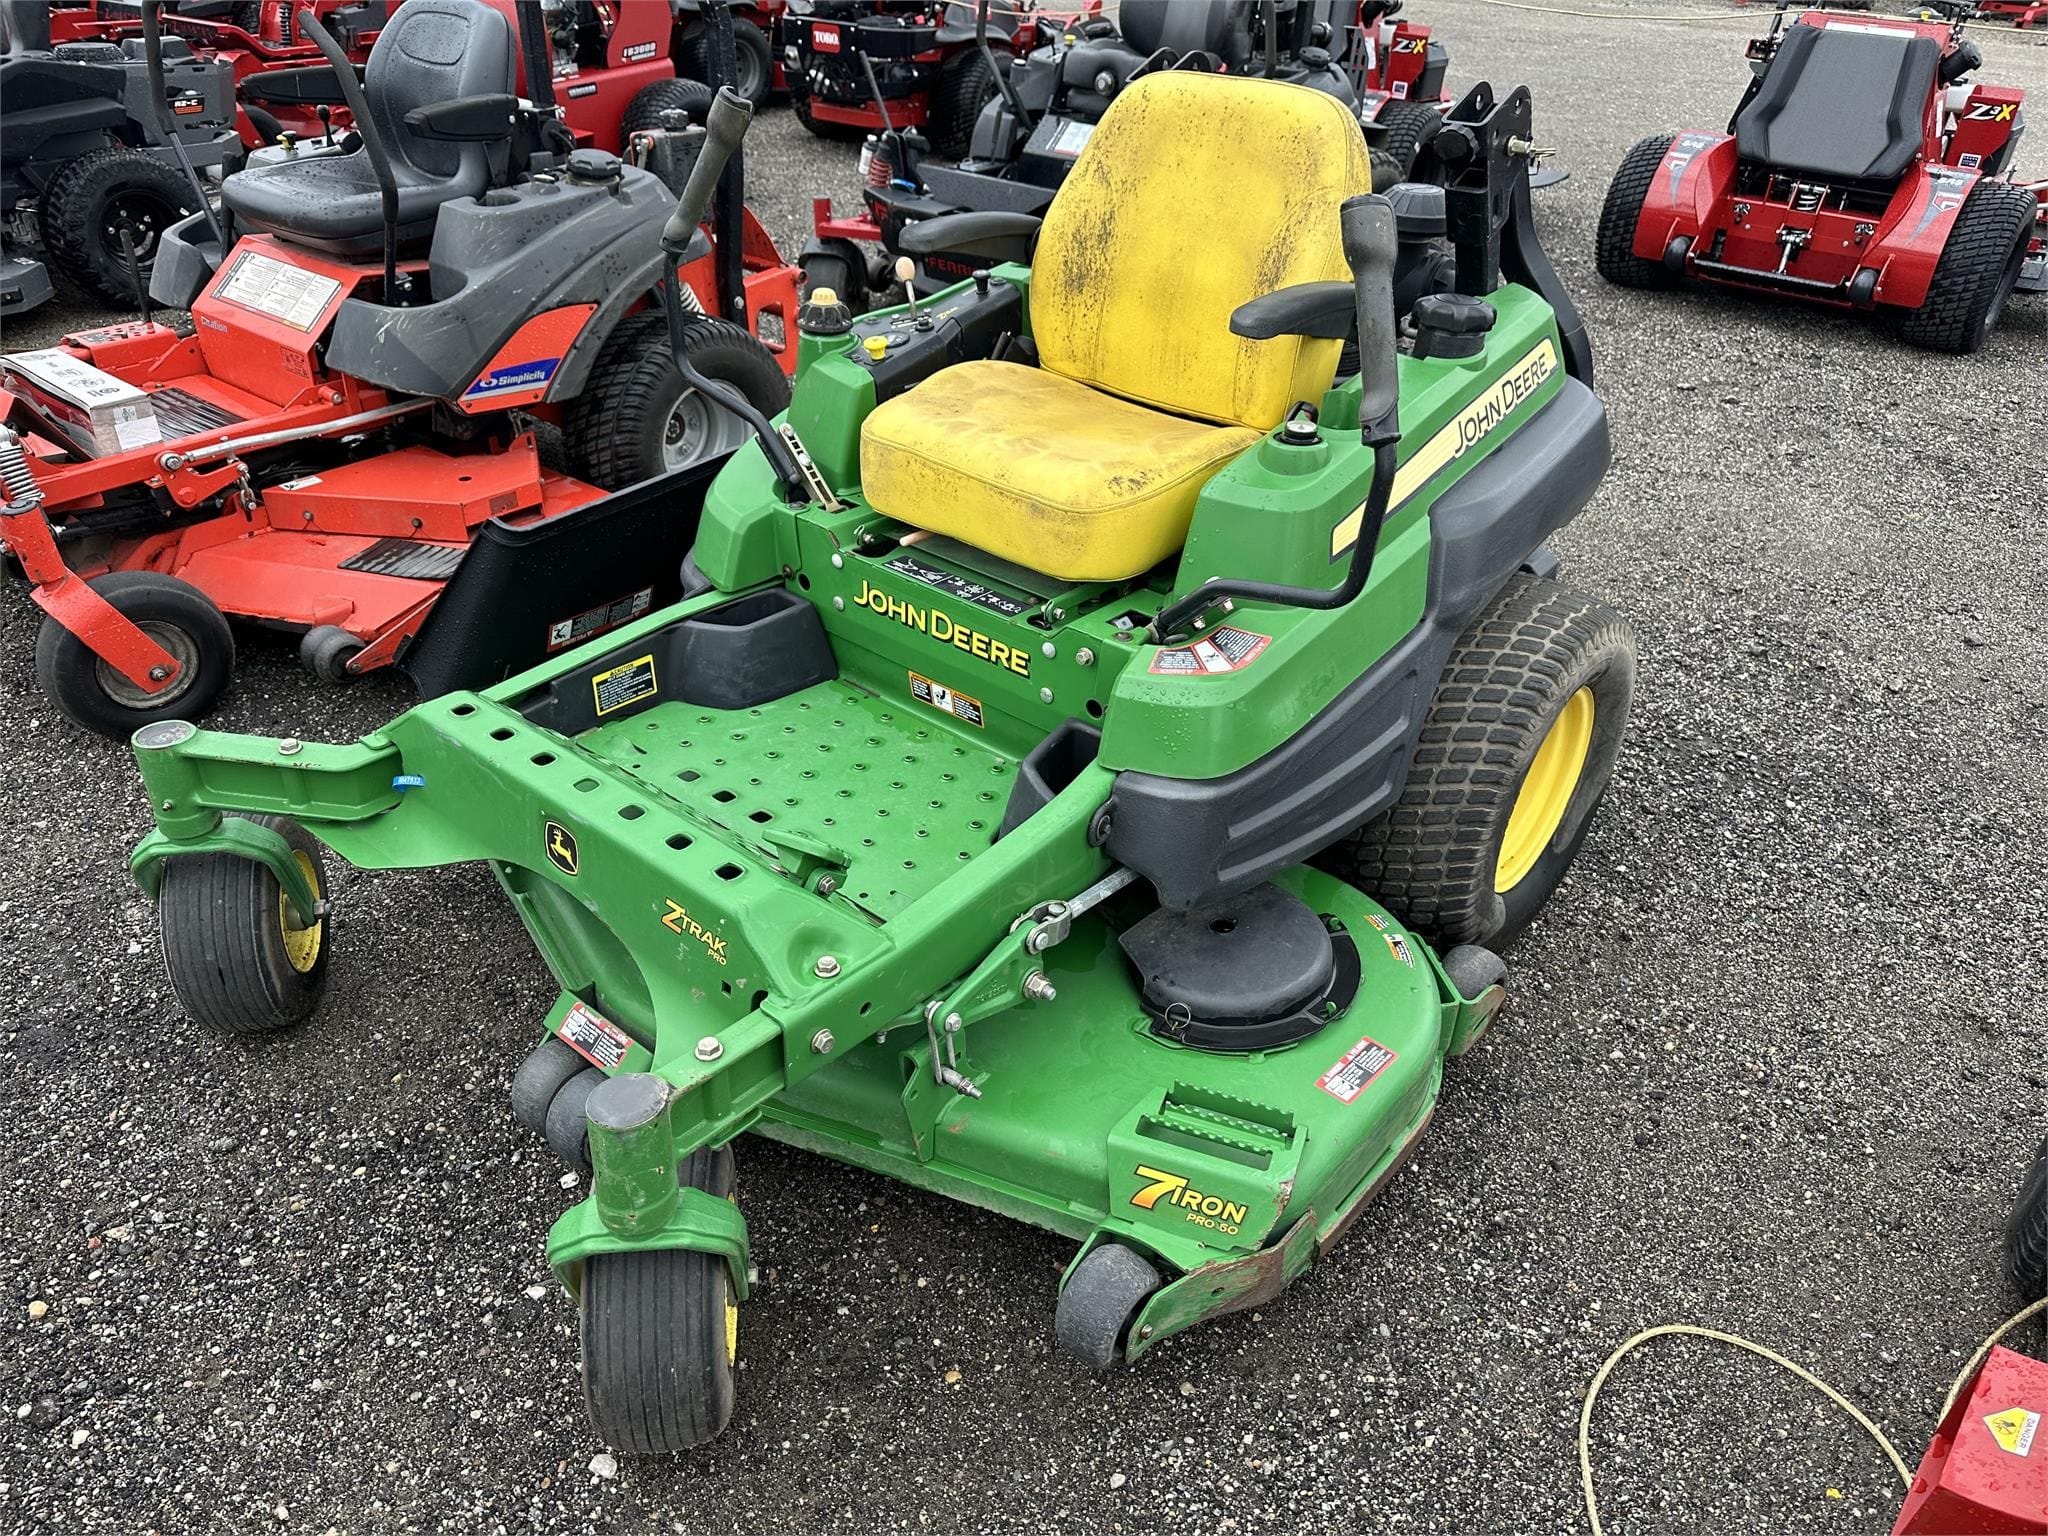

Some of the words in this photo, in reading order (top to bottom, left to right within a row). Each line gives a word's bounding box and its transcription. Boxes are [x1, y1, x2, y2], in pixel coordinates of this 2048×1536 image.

[813, 30, 840, 45] TORO
[1963, 102, 2016, 122] Z3X
[498, 370, 546, 386] Simplicity
[1455, 395, 1502, 454] JOHN
[1501, 352, 1548, 411] DEERE
[853, 579, 927, 633] JOHN
[930, 608, 1031, 678] DEERE
[706, 948, 728, 967] PRO
[2018, 1417, 2036, 1449] DANGER
